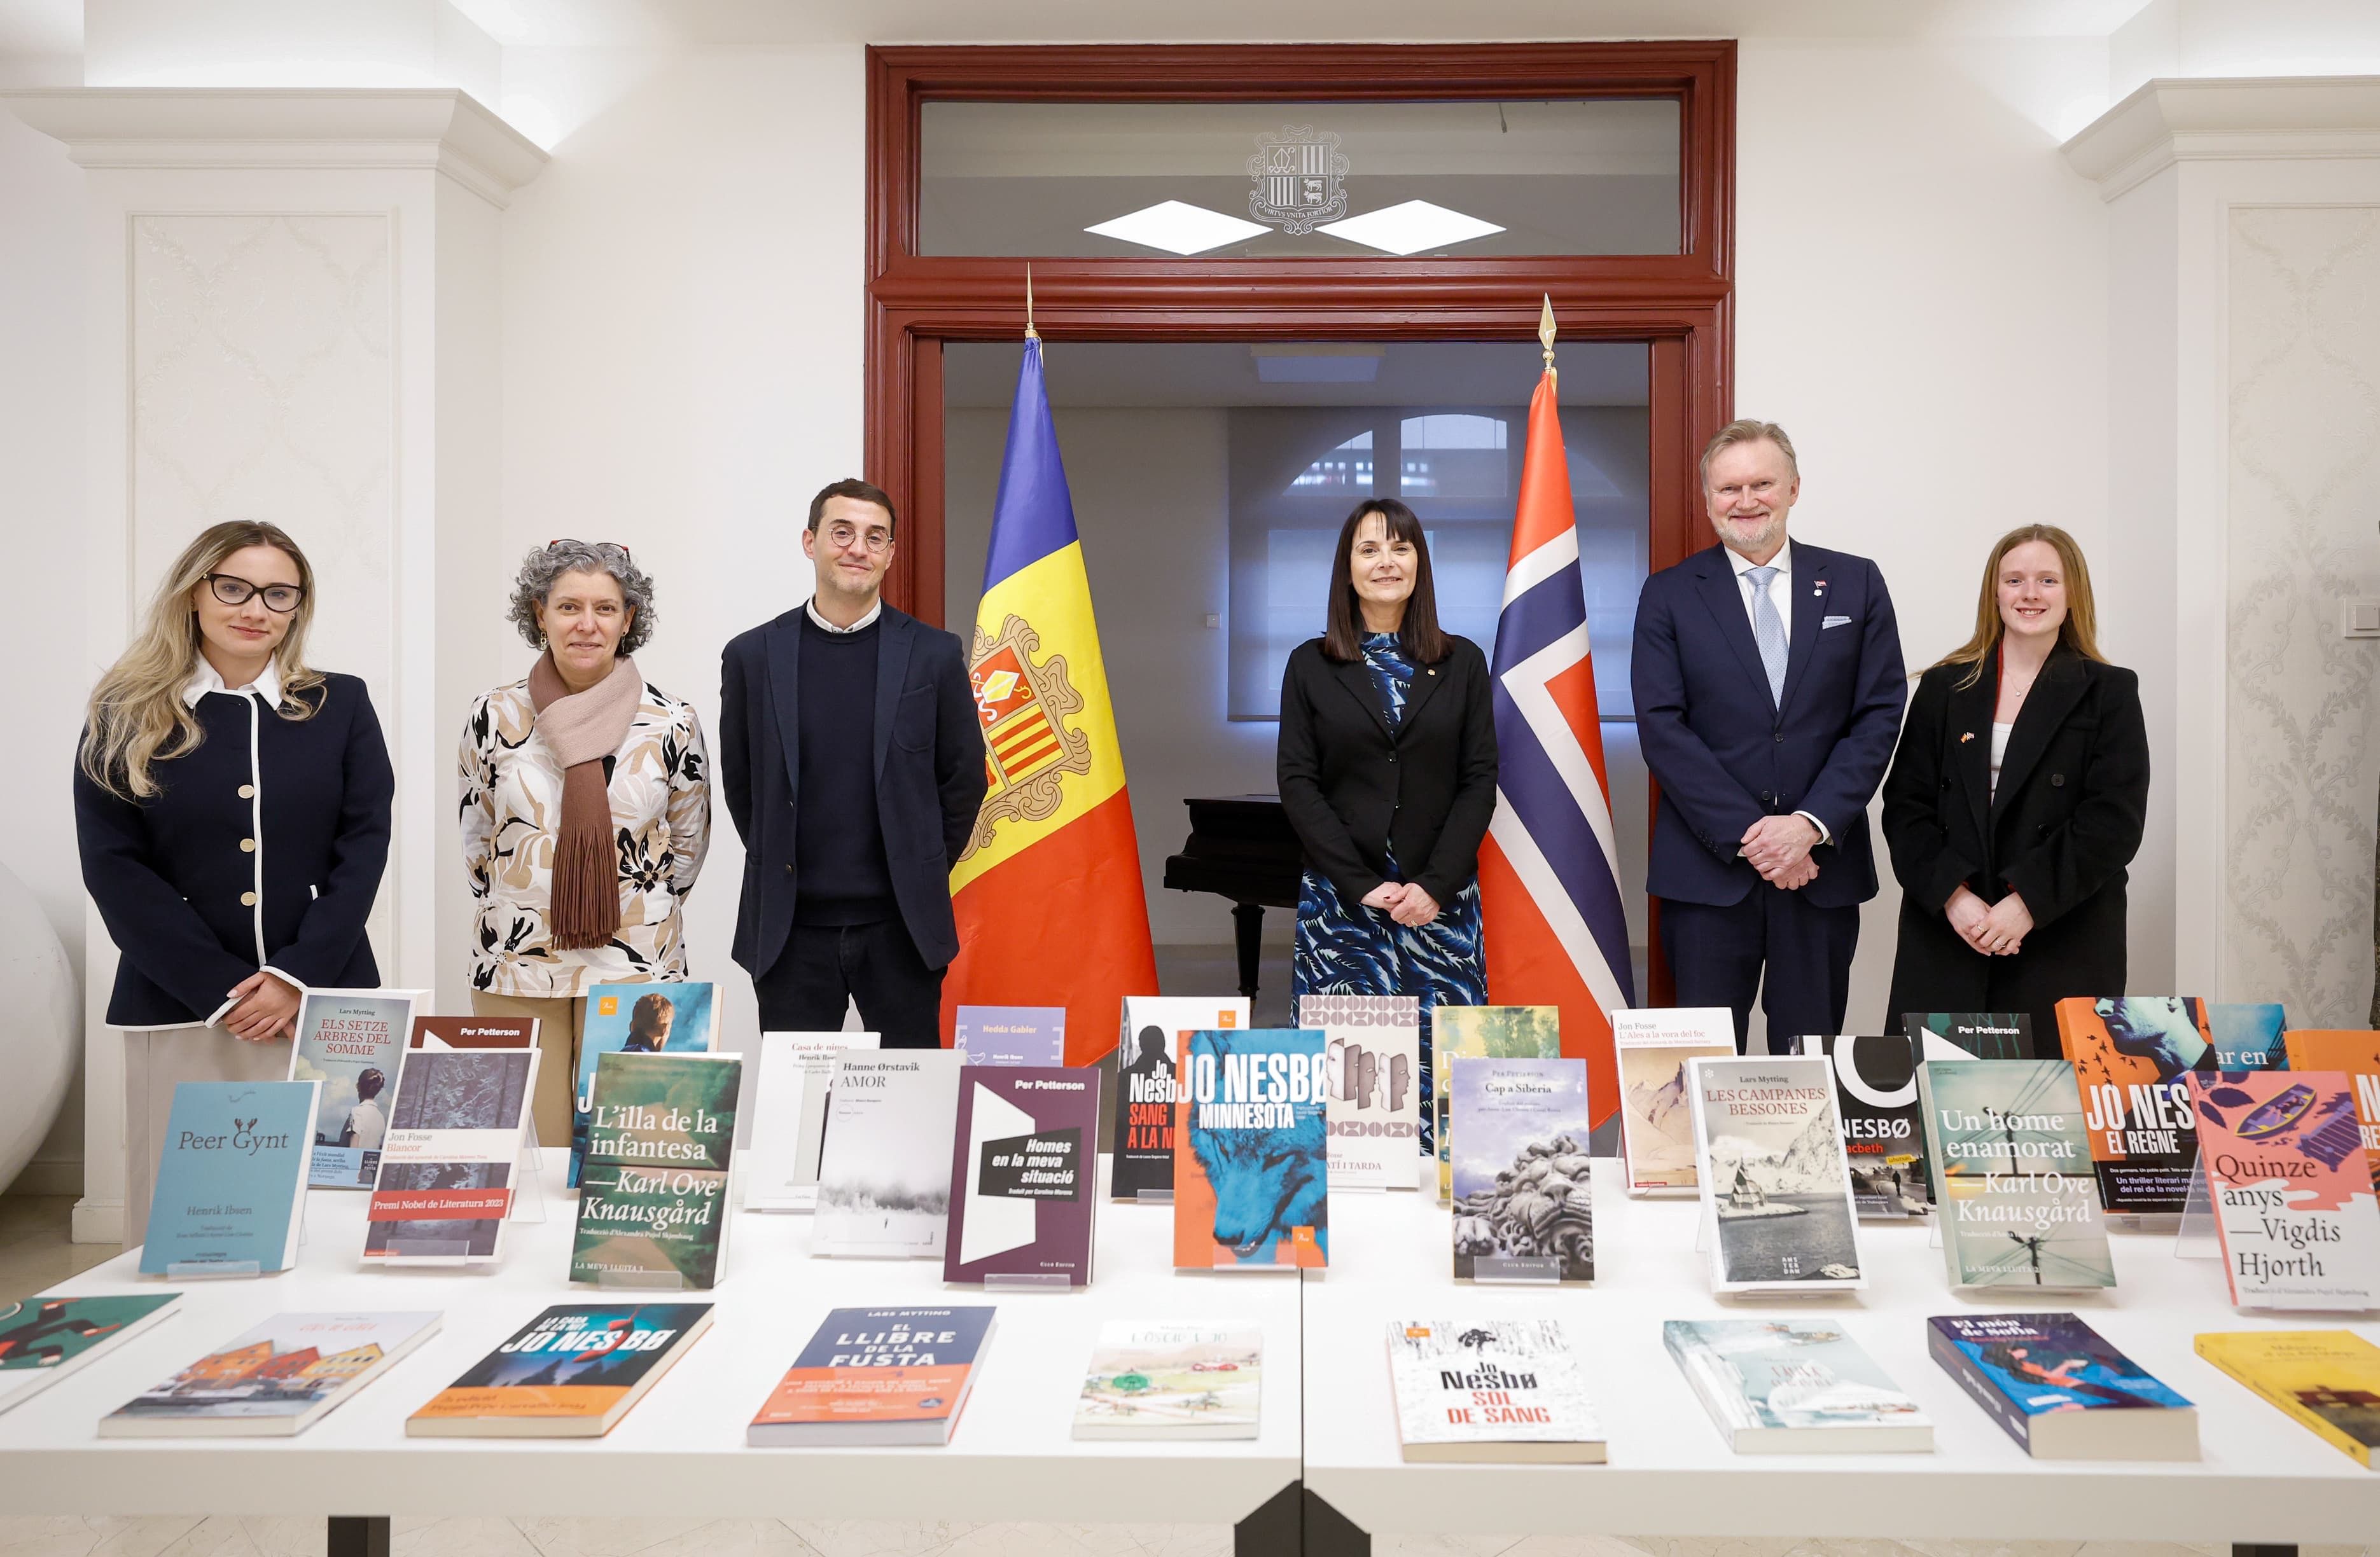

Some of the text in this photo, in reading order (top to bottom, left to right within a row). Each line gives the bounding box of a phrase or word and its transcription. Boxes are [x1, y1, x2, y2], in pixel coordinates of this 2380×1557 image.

[1264, 207, 1285, 218] VIRTVS
[1307, 206, 1333, 218] FORTIOR
[321, 1019, 388, 1032] ELS SETZE
[461, 1028, 520, 1037] Per Petterson
[983, 1025, 1037, 1034] Hedda Gabler
[1958, 1026, 2020, 1035] Per Petterson
[314, 1031, 391, 1044] ARBRES DEL
[326, 1043, 375, 1055] SOMME
[792, 1043, 811, 1051] Casa
[814, 1043, 824, 1051] de
[2241, 1051, 2269, 1065] en
[843, 1063, 875, 1071] Hanne
[878, 1063, 920, 1072] Ørstavik
[1152, 1060, 1167, 1080] Jo
[840, 1076, 886, 1088] AMOR
[1015, 1080, 1085, 1091] Per Petterson
[1177, 1053, 1326, 1105] JO NESBØ
[1758, 1076, 1789, 1084] Mytting
[1129, 1073, 1176, 1104] Nesb
[1486, 1084, 1505, 1095] Cap
[1515, 1083, 1552, 1093] Sibèria
[1706, 1088, 1826, 1102] LES CAMPANES
[1730, 1103, 1808, 1116] BESSONES
[2087, 1083, 2196, 1131] JO NES
[594, 1105, 718, 1133] L'illa de la
[1129, 1104, 1167, 1126] SANG
[1199, 1104, 1295, 1129] MINNESOTA
[1940, 1107, 2066, 1131] Un home
[1843, 1118, 1911, 1138] NESBØ
[178, 1131, 289, 1156] Peer Gynt
[389, 1133, 433, 1142] Jon Fosse
[1127, 1127, 1158, 1149] A LA
[2106, 1131, 2181, 1154] EL REGNE
[387, 1144, 422, 1152] Blancor
[590, 1133, 707, 1161] infantesa
[1026, 1138, 1071, 1153] Homes
[1848, 1143, 1883, 1153] acbeth
[1947, 1140, 2077, 1158] enamorat
[992, 1153, 1063, 1168] en la meva
[1349, 1162, 1382, 1170] TARDA
[2216, 1154, 2318, 1184] Quinze
[1020, 1170, 1074, 1184] situació
[2043, 1172, 2090, 1194] Ove
[672, 1172, 718, 1197] Ove
[374, 1199, 504, 1210] Premi Nobel de Literatura 2023
[2224, 1189, 2283, 1214] anys
[187, 1204, 252, 1215] Henrik Ibsen
[581, 1196, 713, 1231] Knausgård
[1957, 1198, 2092, 1230] Knausgård
[587, 1263, 608, 1271] MEVA
[2238, 1252, 2326, 1284] Hjorth
[1951, 1319, 1975, 1329] El
[1960, 1326, 2039, 1336] de Sofia
[499, 1329, 677, 1353] JO NESBØ
[835, 1331, 956, 1346] LLIBRE
[893, 1345, 913, 1353] LA
[828, 1353, 936, 1367] FUSTA
[1475, 1362, 1497, 1374] Jo
[1440, 1371, 1538, 1390] Nesbø
[1472, 1392, 1517, 1406] SOL
[1447, 1408, 1551, 1425] DE SANG
